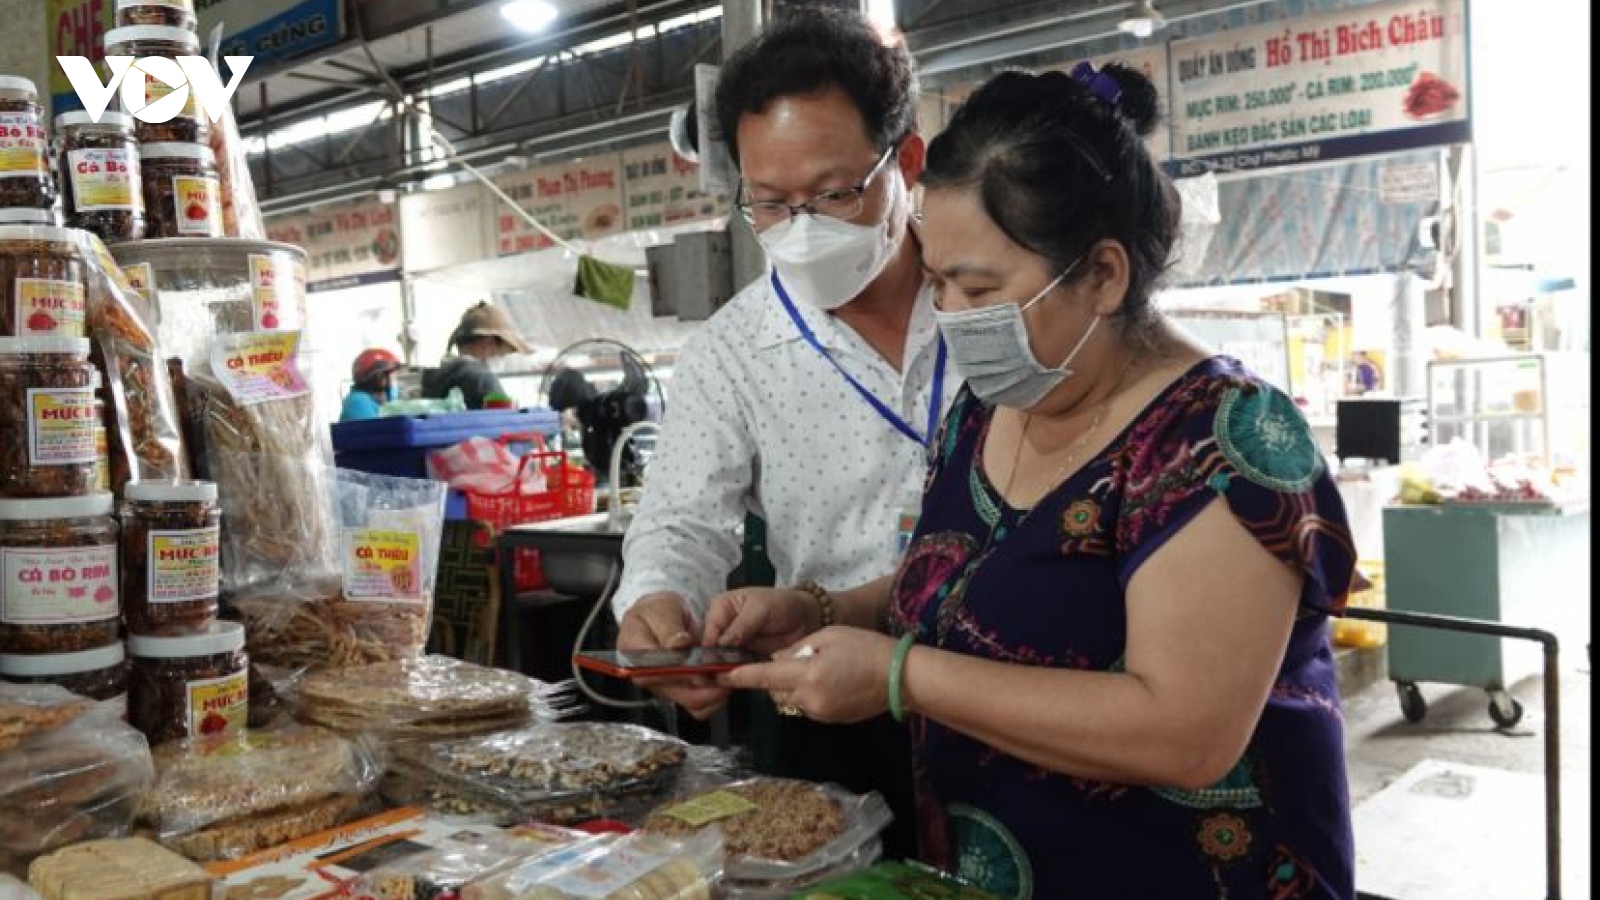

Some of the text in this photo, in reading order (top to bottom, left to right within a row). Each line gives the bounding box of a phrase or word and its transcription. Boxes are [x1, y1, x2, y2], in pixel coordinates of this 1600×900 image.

[1266, 29, 1292, 68] Hồ
[1297, 28, 1330, 65] Thị
[18, 566, 43, 583] CÁ
[81, 562, 110, 581] RIM
